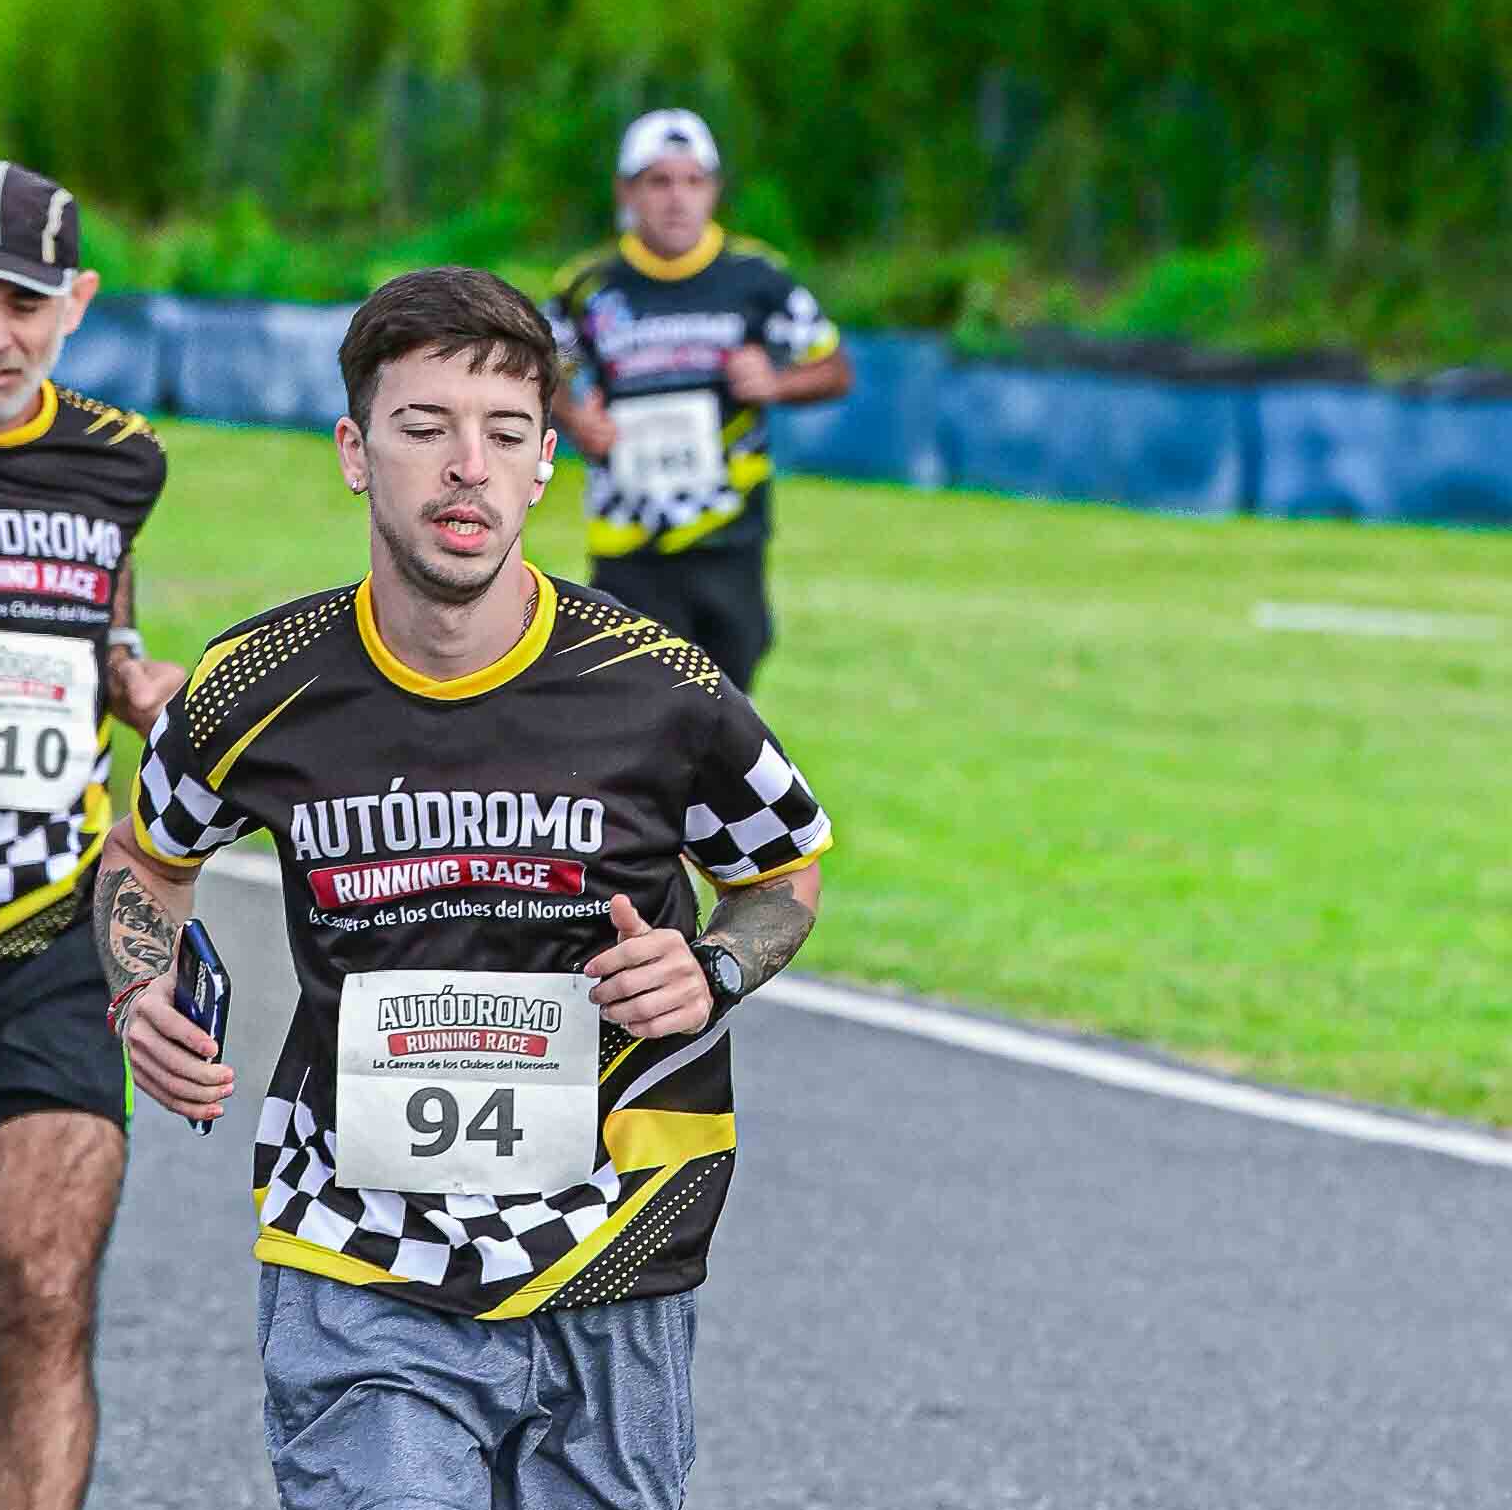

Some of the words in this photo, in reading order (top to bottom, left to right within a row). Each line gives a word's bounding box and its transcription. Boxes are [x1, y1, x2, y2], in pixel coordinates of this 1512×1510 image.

[290, 776, 605, 860] AUTÓDROMO
[332, 859, 462, 904] RUNNING
[469, 860, 551, 889] RACE
[373, 909, 397, 926] de
[401, 905, 428, 924] los
[430, 899, 491, 919] Clubes
[494, 899, 523, 919] del
[527, 899, 611, 919] Noroeste
[378, 984, 562, 1033] AUTÓDROMO
[373, 1059, 385, 1069] La
[387, 1059, 425, 1069] Carrera
[427, 1059, 440, 1070] de
[443, 1059, 458, 1070] los
[459, 1059, 495, 1070] Clubes
[497, 1059, 512, 1070] del
[406, 1031, 481, 1053] RUNNING
[485, 1032, 530, 1053] RACE
[405, 1086, 524, 1157] 94
